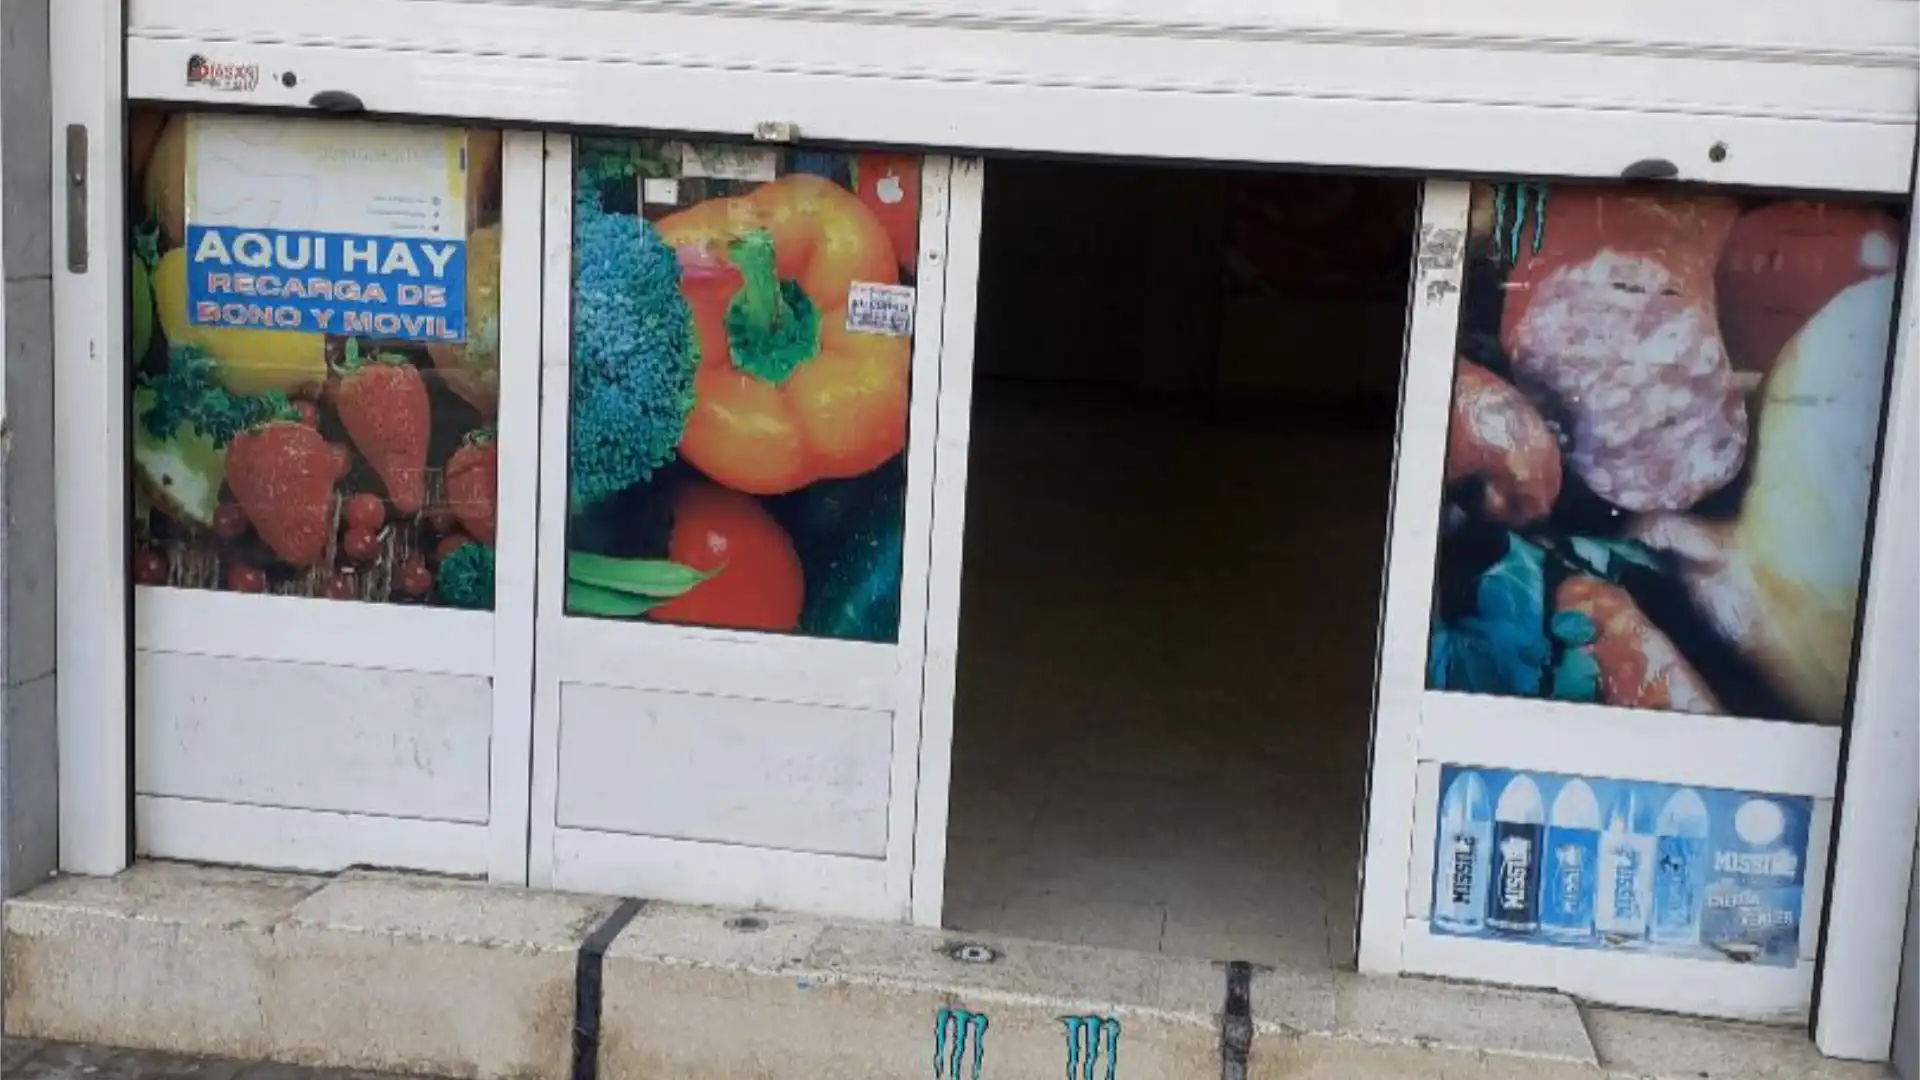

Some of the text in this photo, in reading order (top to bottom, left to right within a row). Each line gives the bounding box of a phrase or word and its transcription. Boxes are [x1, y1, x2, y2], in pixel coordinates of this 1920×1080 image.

[195, 229, 456, 278] AQUI HAY
[207, 271, 447, 307] RECARGA DE
[196, 301, 458, 339] BONO Y MOVIL
